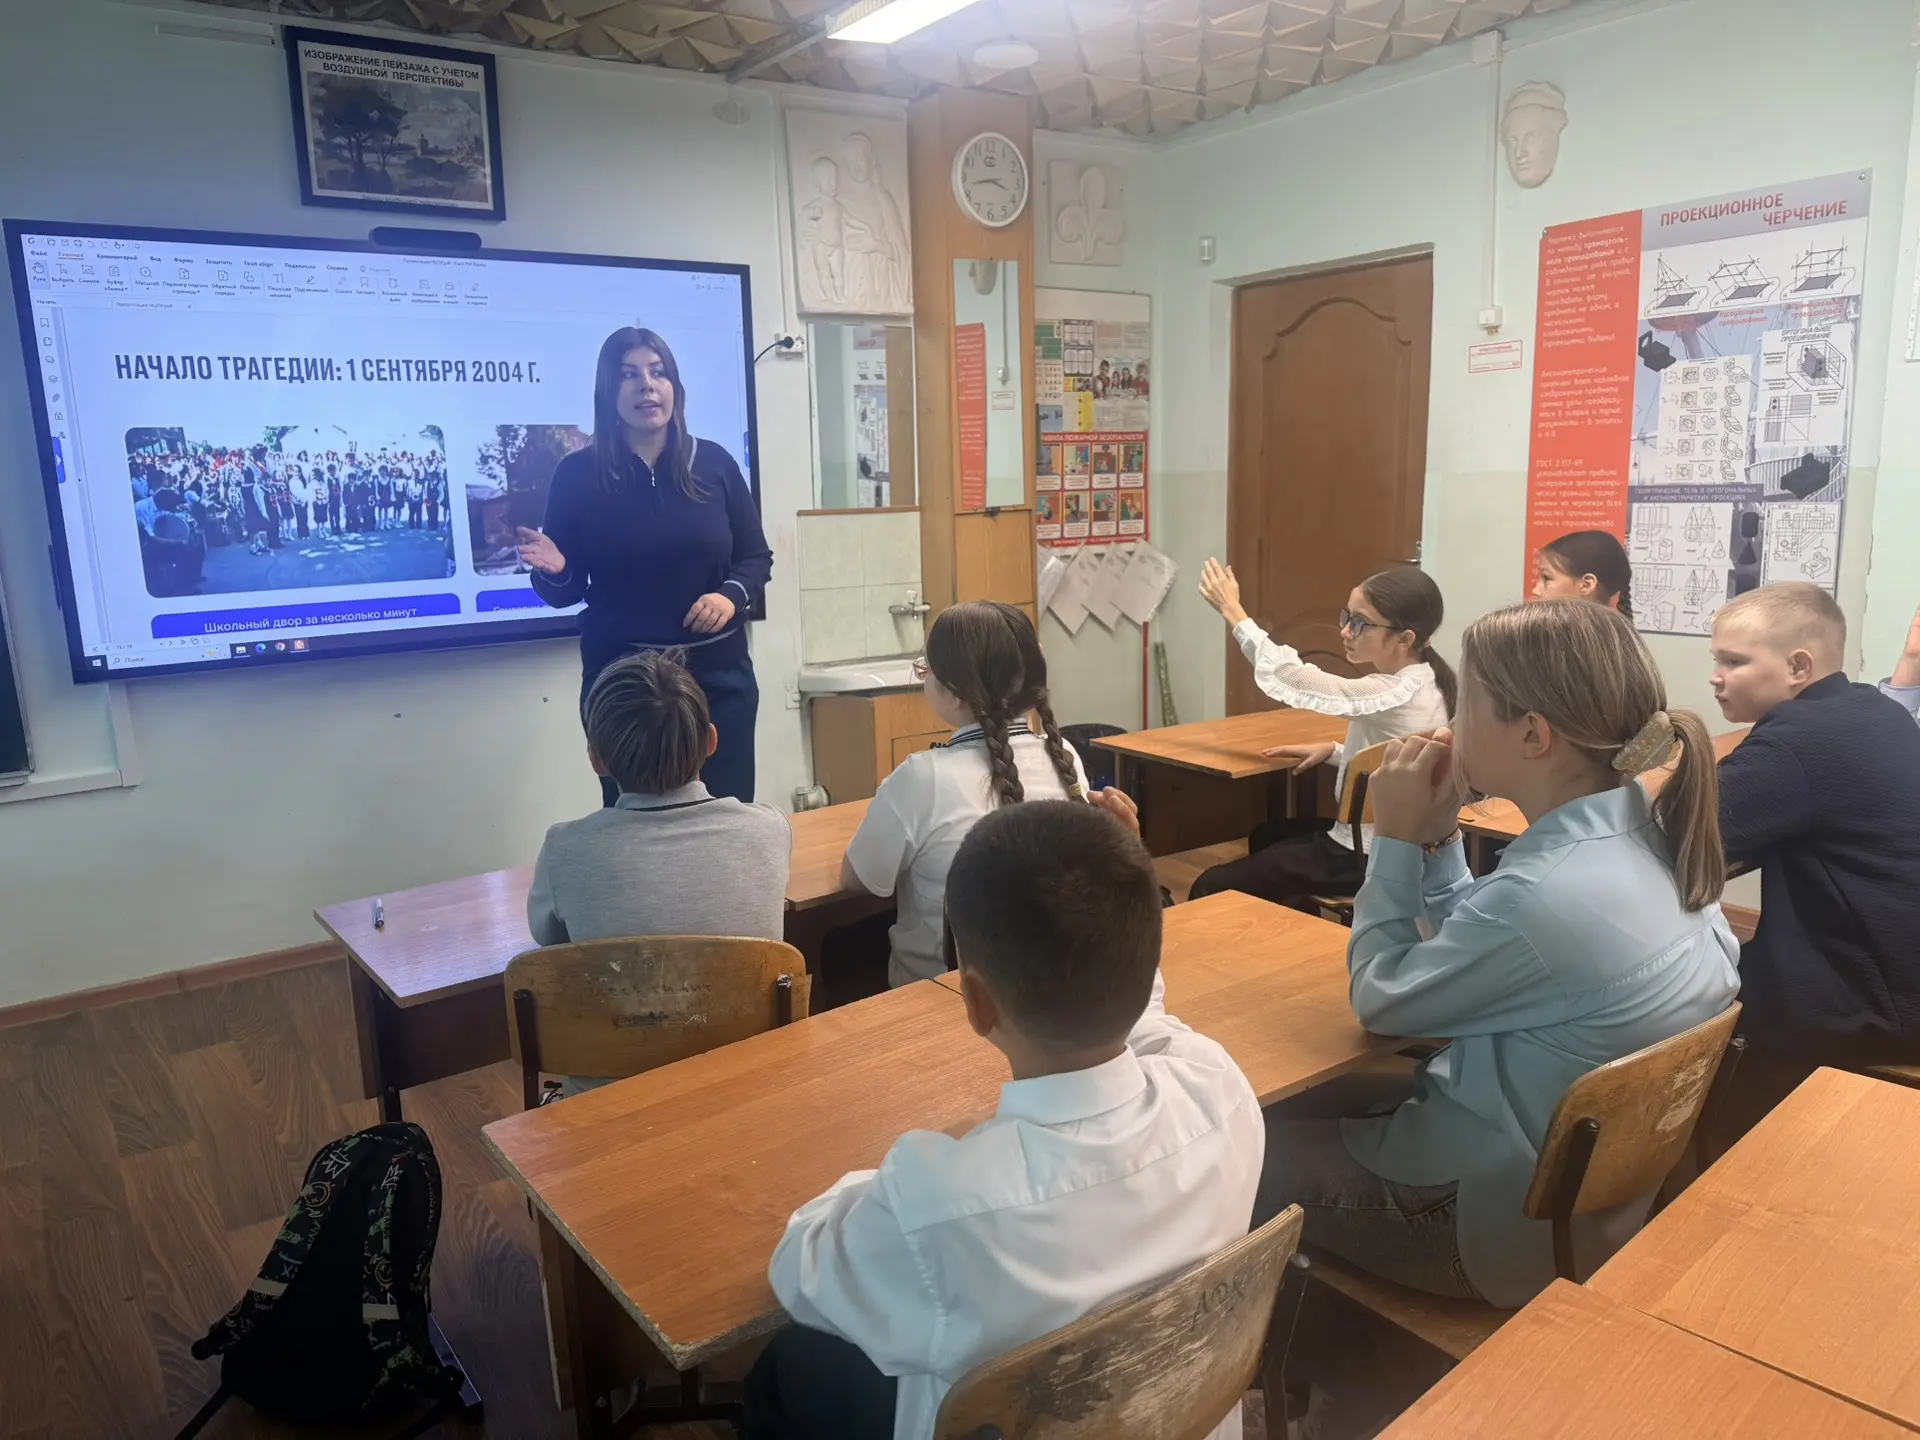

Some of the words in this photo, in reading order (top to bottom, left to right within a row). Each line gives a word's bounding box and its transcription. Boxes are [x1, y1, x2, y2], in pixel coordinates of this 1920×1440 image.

[304, 49, 381, 67] ИЗОБРАЖЕНИЕ
[383, 59, 430, 73] ПЕЙЗАЖА
[432, 66, 439, 74] С
[441, 67, 479, 80] УЧЕТОМ
[323, 62, 388, 78] ВОЗДУШНОЙ
[392, 72, 464, 88] ПЕРСПЕКТИВЫ
[1660, 193, 1784, 227] ПРОЕКЦИОННОЕ
[1762, 199, 1848, 226] ЧЕРЧЕНИЕ
[114, 354, 213, 381] НАЧАЛО
[217, 356, 342, 384] ТРАГЕДИИ:
[346, 358, 356, 382] 1
[361, 359, 467, 383] СЕНТЯБРЯ
[471, 360, 524, 383] 2004
[528, 361, 540, 383] Г.
[204, 618, 270, 634] Школьный
[273, 617, 303, 630] двор
[305, 616, 318, 625] за
[321, 611, 381, 624] несколько
[383, 608, 417, 621] минут
